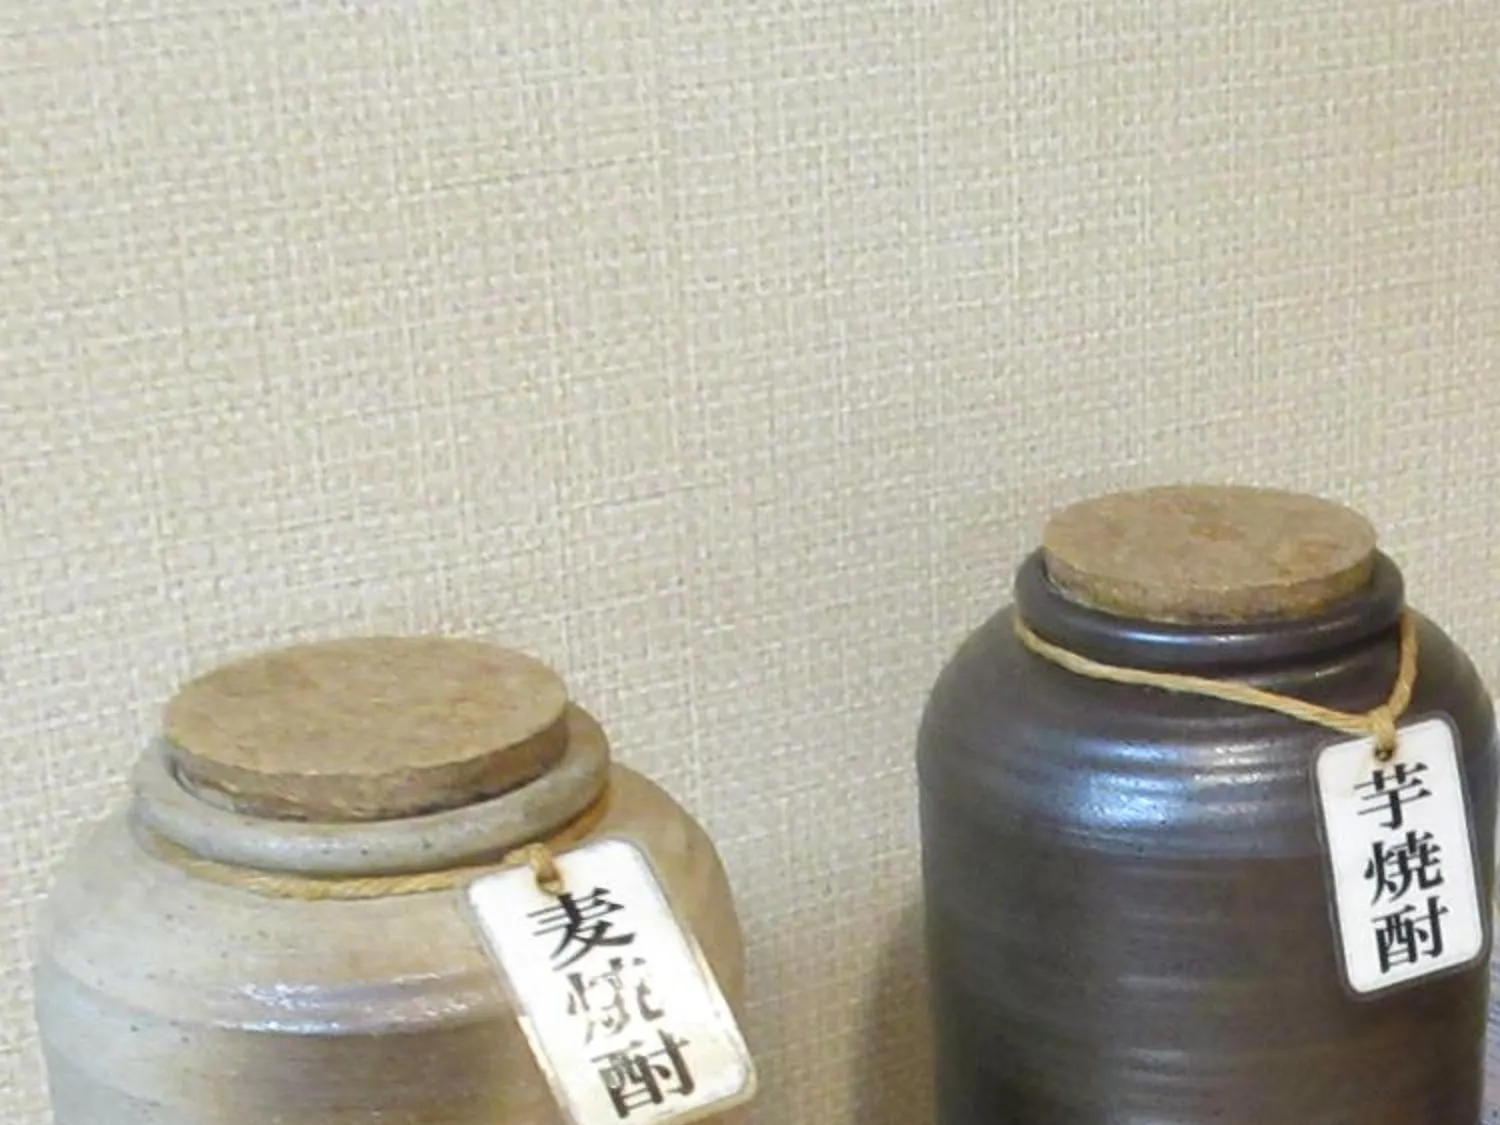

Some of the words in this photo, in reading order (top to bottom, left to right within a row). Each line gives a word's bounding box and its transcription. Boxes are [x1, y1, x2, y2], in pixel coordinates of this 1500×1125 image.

[1354, 762, 1449, 974] 芋焼酎
[526, 886, 695, 1119] 麦焼酎
